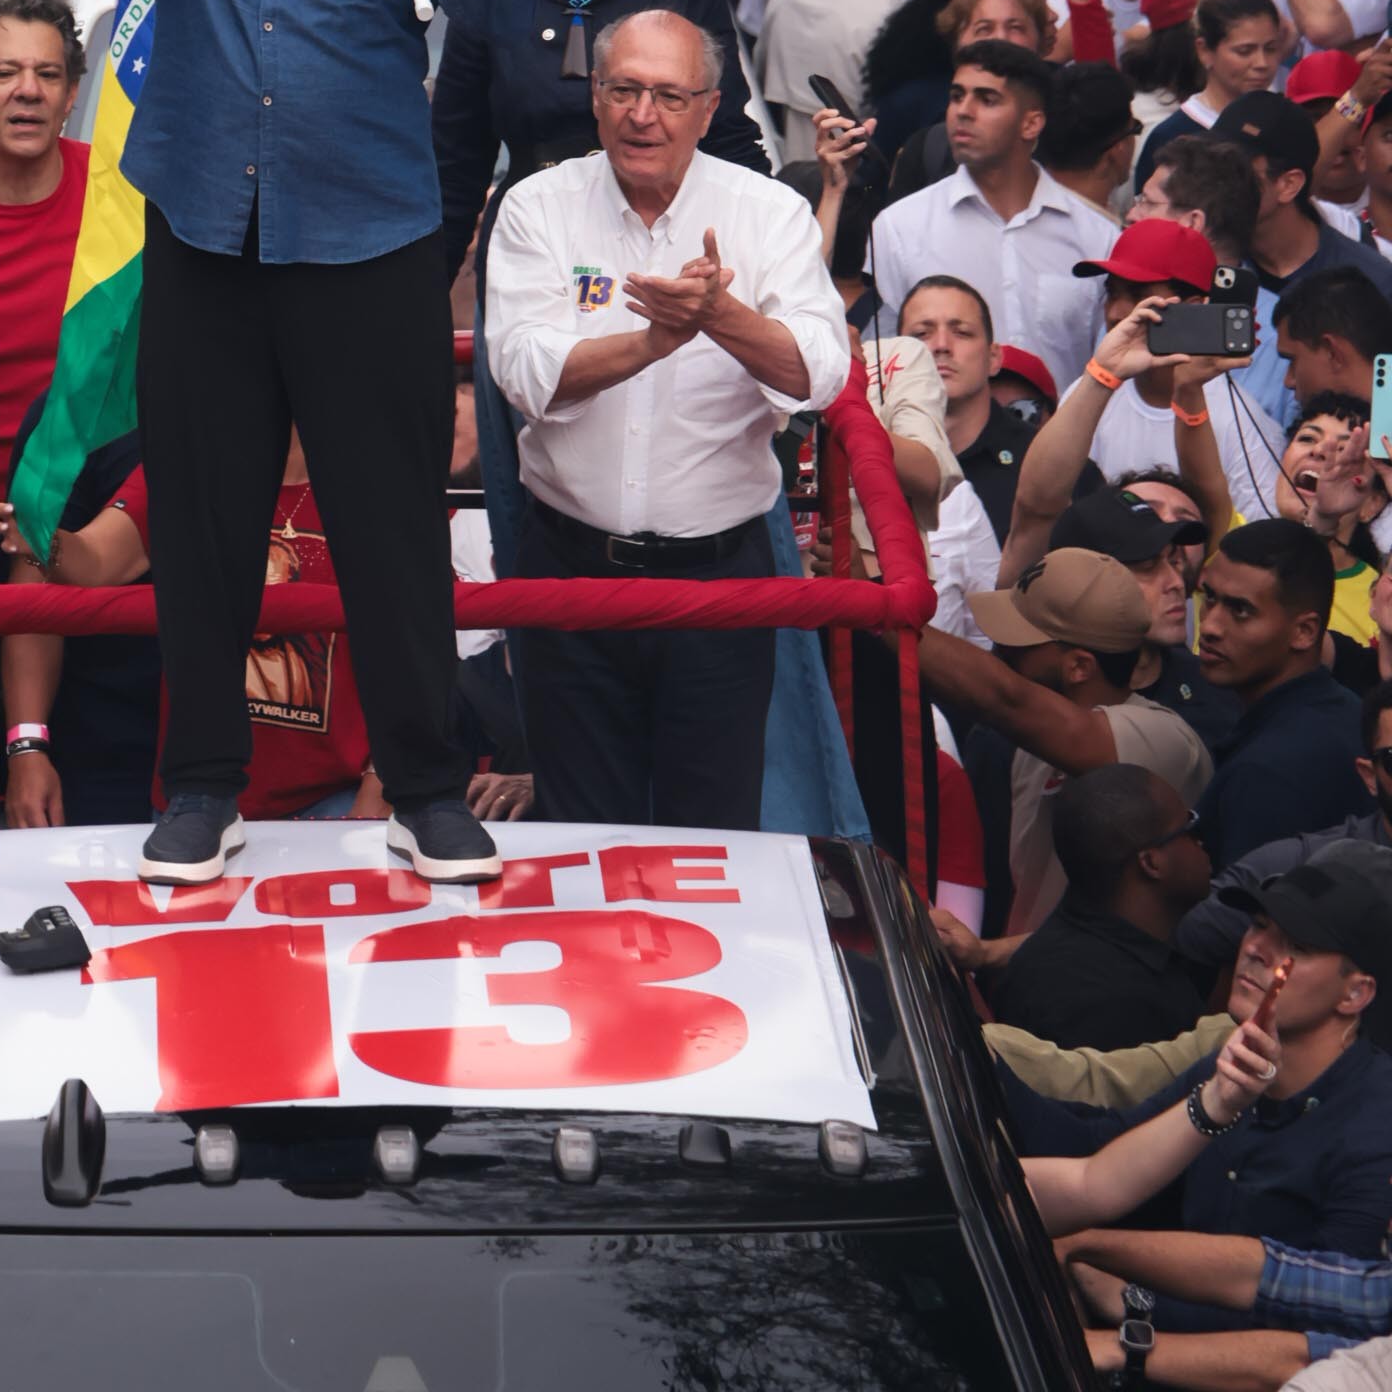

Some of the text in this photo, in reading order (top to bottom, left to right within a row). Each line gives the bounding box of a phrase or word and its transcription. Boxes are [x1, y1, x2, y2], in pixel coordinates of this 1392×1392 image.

[578, 274, 614, 305] 13
[65, 844, 742, 926] VOTE
[79, 909, 750, 1113] 13
